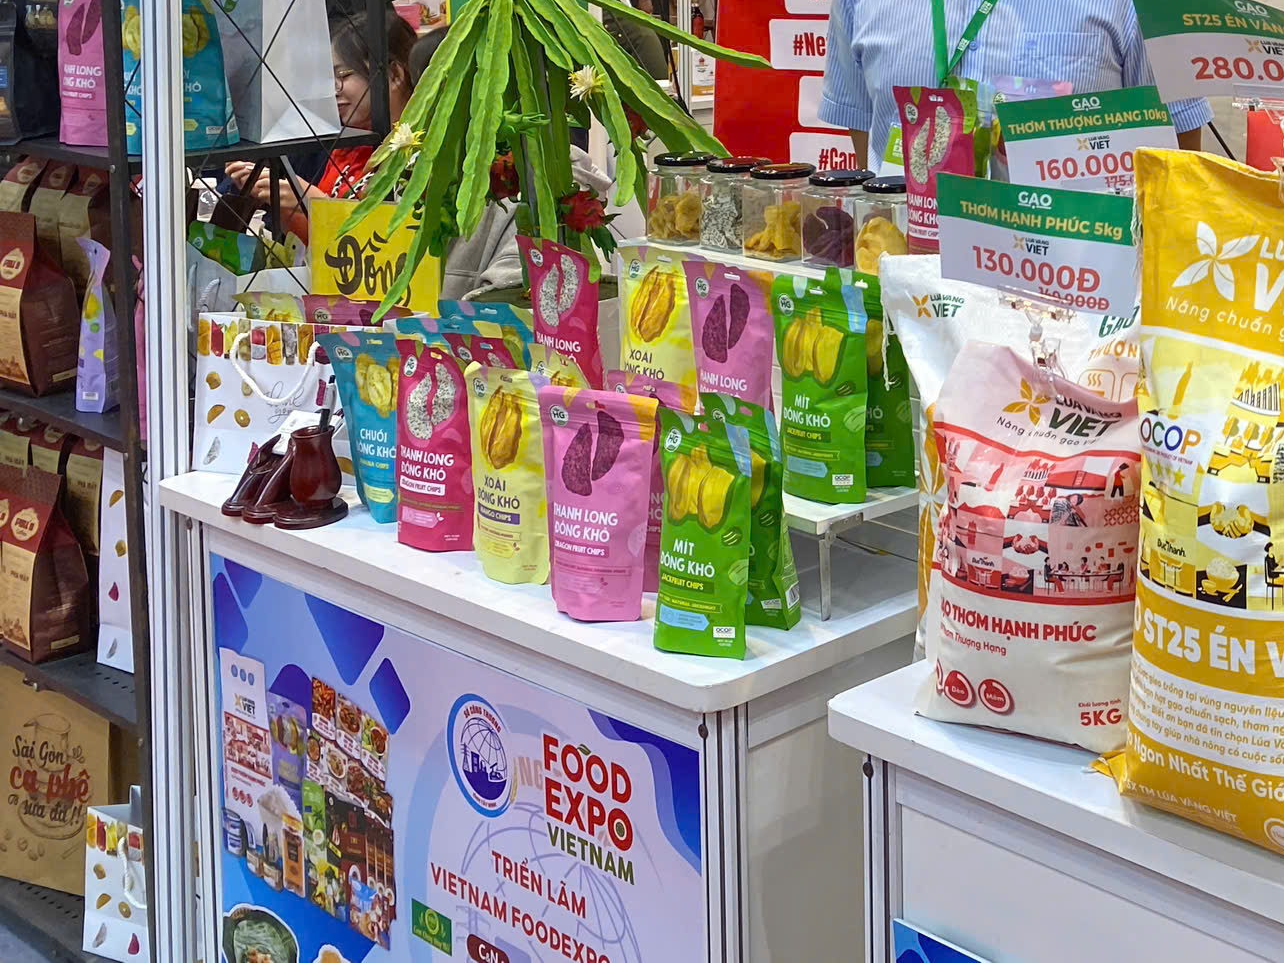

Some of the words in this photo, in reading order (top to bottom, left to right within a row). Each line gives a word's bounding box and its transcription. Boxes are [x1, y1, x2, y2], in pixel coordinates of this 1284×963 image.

[77, 65, 102, 77] LONG
[1071, 96, 1101, 111] GẠO
[1008, 121, 1047, 135] THƠM
[1049, 114, 1102, 134] THƯỢNG
[1104, 110, 1141, 127] HẠNG
[1142, 108, 1168, 124] 10kg
[959, 201, 998, 219] THƠM
[1001, 209, 1041, 229] HẠNH
[1045, 211, 1090, 234] PHÚC
[1094, 221, 1123, 241] 5kg
[972, 245, 1101, 292] 130.000Đ
[1166, 296, 1210, 322] Nâng
[1216, 308, 1272, 335] chuẩn
[555, 340, 581, 353] LONG
[720, 375, 747, 391] LONG
[794, 392, 809, 411] MÍT
[360, 428, 388, 443] CHUỐI
[1049, 408, 1120, 437] VIET
[1140, 417, 1201, 455] OCOP
[401, 445, 423, 464] THANH
[424, 452, 454, 467] LONG
[553, 503, 582, 524] THANH
[584, 509, 618, 526] LONG
[554, 520, 581, 541] ĐÔNG
[583, 524, 610, 543] KHÔ
[673, 538, 694, 557] MÍT
[687, 559, 715, 578] KHÔ
[953, 607, 989, 630] THƠM
[991, 618, 1039, 641] HẠNH
[1043, 621, 1096, 643] PHÚC
[1144, 610, 1201, 664] ST25
[1210, 622, 1256, 675] ÉN
[1080, 708, 1121, 727] 5KG
[12, 735, 35, 760] Sài
[39, 739, 66, 767] Gòn
[1135, 737, 1165, 769] Ngon
[1168, 749, 1210, 783] Nhất
[1212, 764, 1247, 794] Thế
[543, 734, 632, 804] FOOD
[10, 764, 38, 793] cà
[47, 764, 90, 806] phê
[545, 777, 633, 852] EXPO
[547, 822, 635, 886] VIETNAM
[430, 862, 507, 924] VIETNAM
[492, 850, 542, 897] TRIỂN
[547, 879, 586, 919] LÃM
